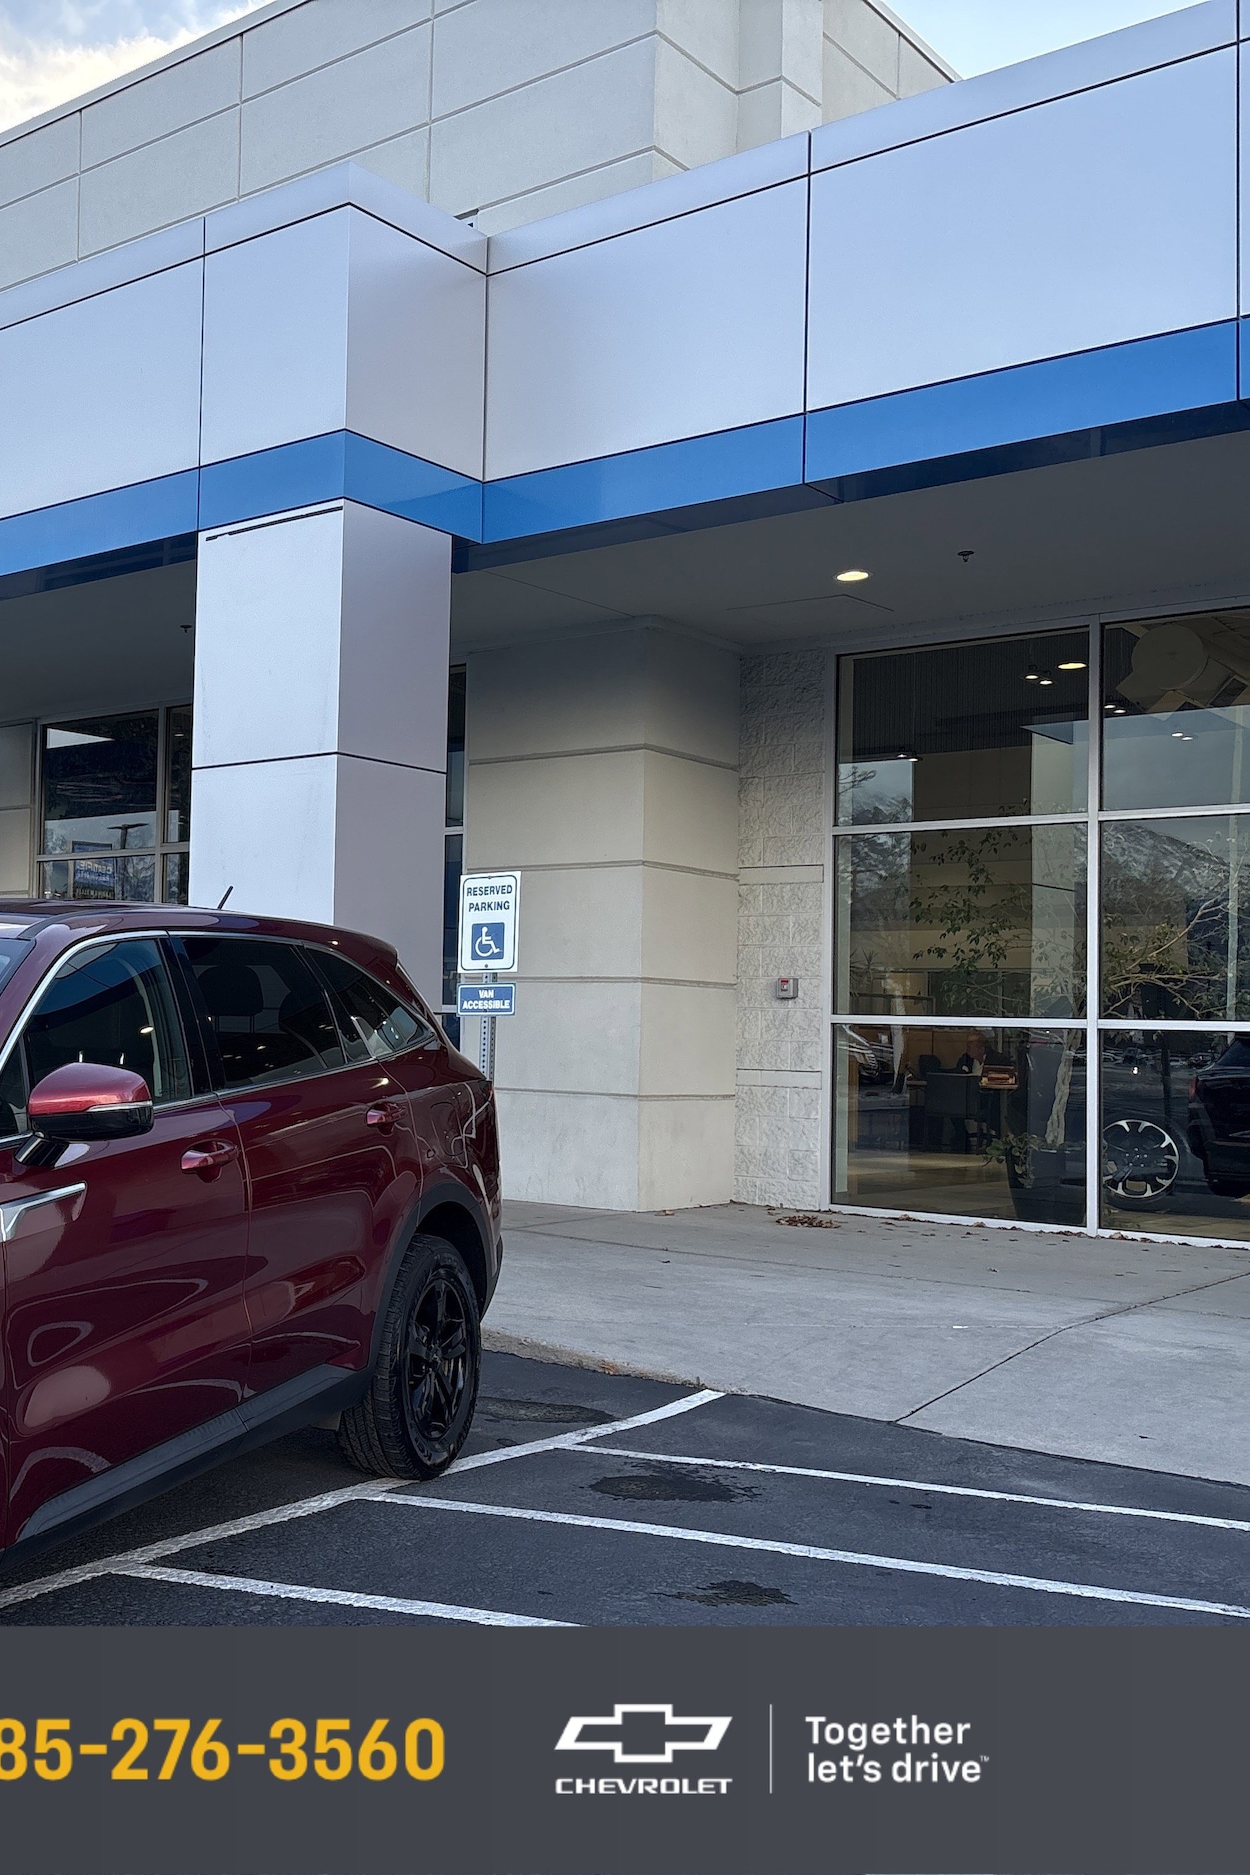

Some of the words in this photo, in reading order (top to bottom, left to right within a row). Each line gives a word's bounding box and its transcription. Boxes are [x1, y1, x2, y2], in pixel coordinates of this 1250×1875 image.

[466, 884, 513, 897] RESERVED
[468, 900, 510, 912] PARKING
[478, 989, 494, 999] VAN
[462, 1000, 510, 1010] ACCESSIBLE
